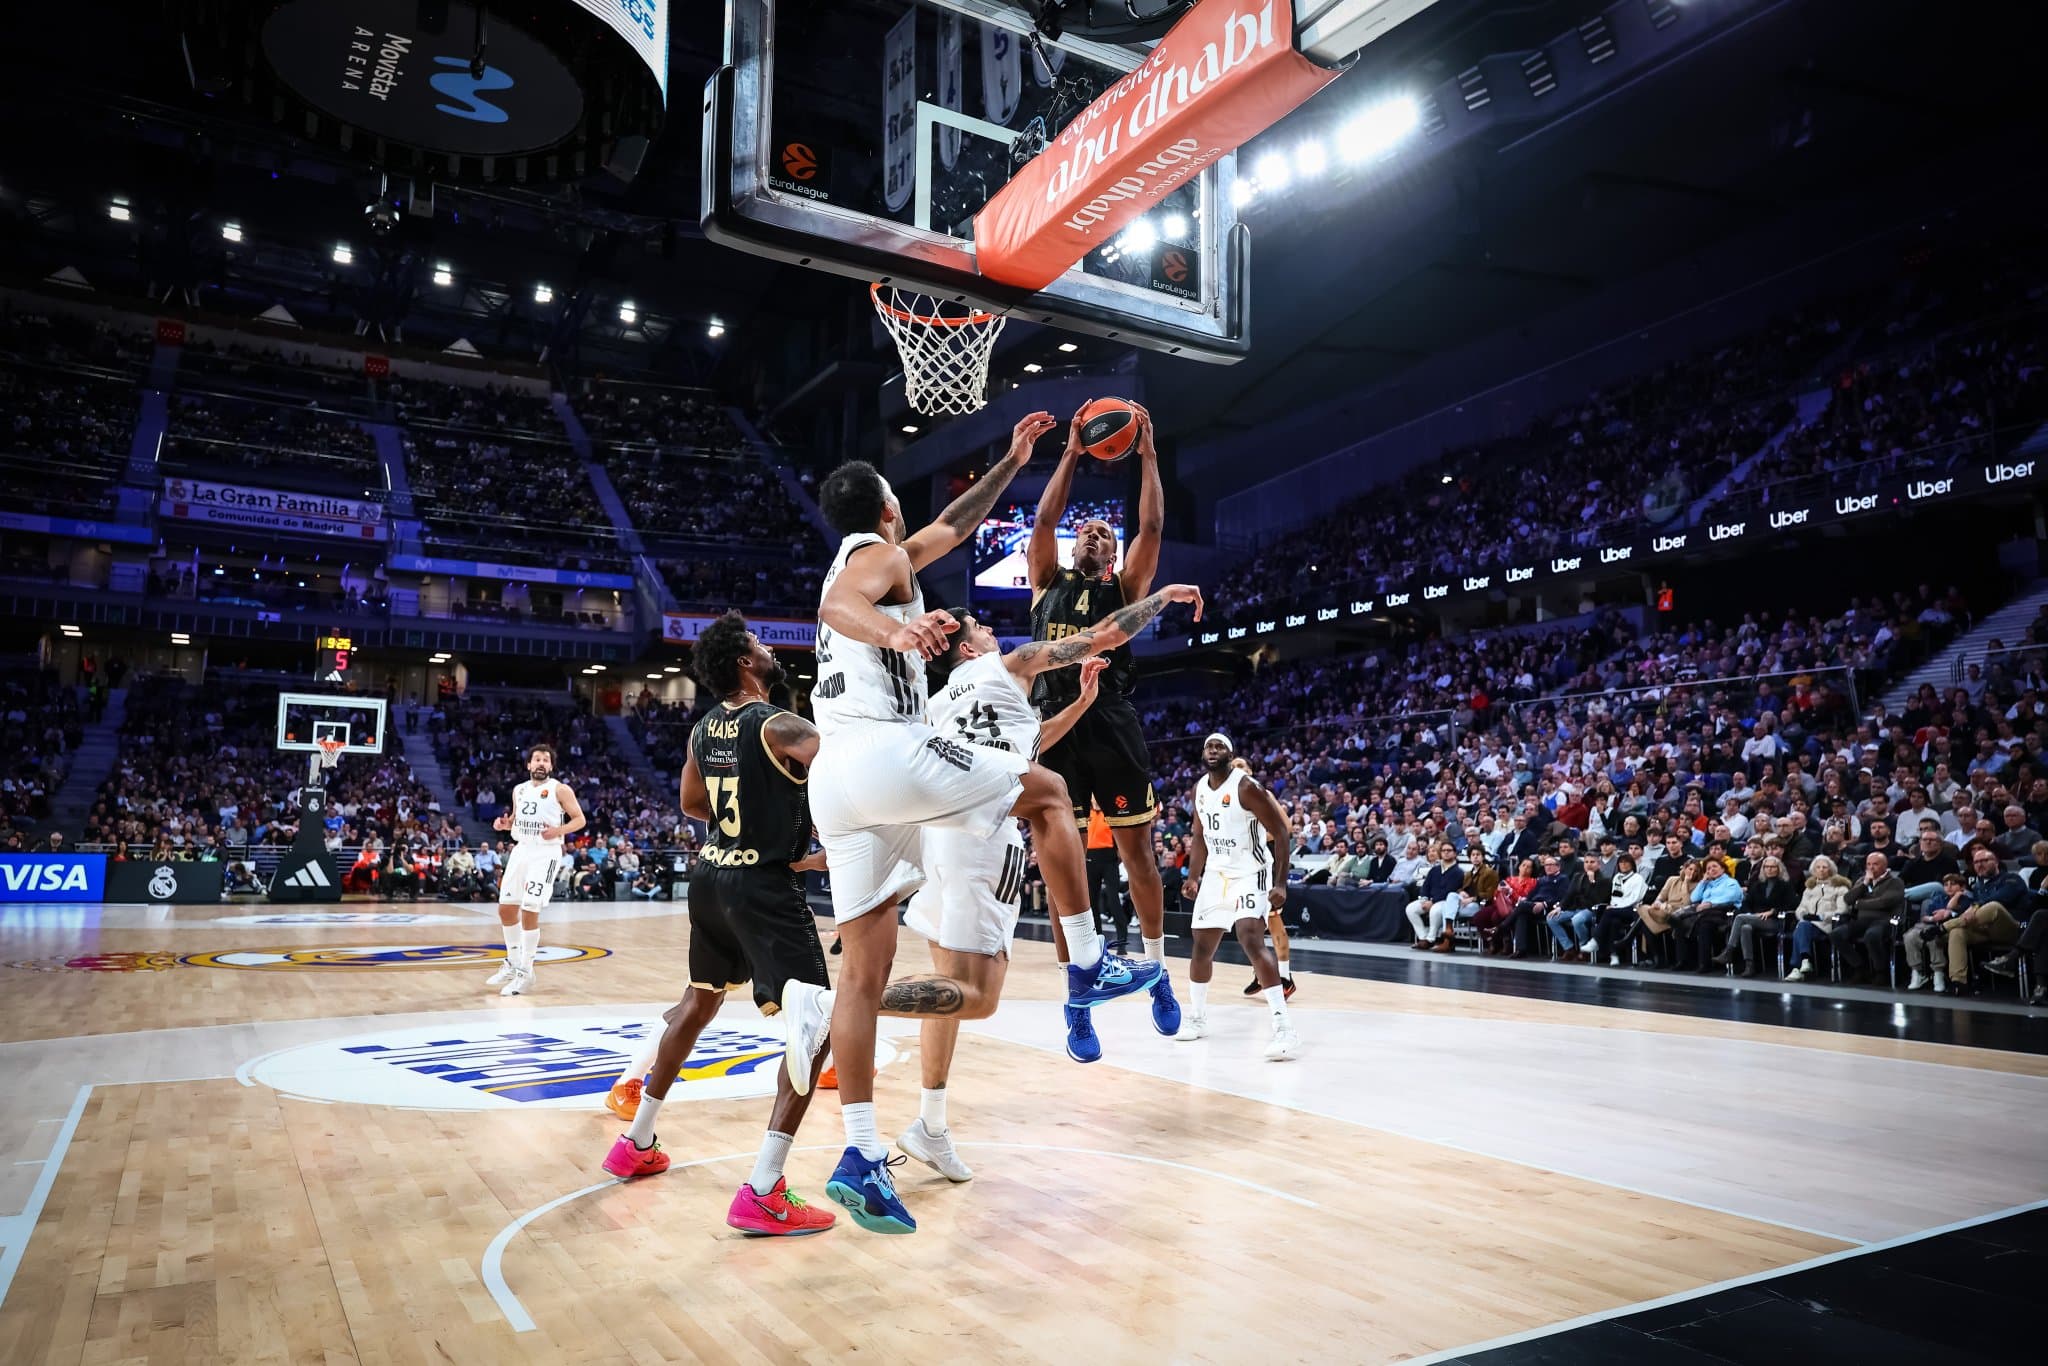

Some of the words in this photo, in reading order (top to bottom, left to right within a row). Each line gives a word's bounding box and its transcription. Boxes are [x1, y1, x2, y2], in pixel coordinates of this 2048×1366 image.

[342, 26, 374, 90] ARENA
[369, 33, 412, 101] Movistar
[1046, 114, 1123, 202] abu
[1128, 0, 1274, 137] dhabi
[1061, 47, 1167, 146] experience
[1136, 137, 1200, 176] abu
[1146, 147, 1221, 197] experience
[769, 176, 829, 199] EuroLeague
[1063, 176, 1145, 235] dhabi
[1153, 280, 1197, 297] EuroLeague
[192, 483, 216, 501] La
[221, 488, 271, 508] Gran
[276, 494, 350, 516] Familia
[208, 509, 279, 525] Comunidad
[284, 517, 298, 527] de
[303, 520, 344, 533] Madrid
[1202, 633, 1218, 643] Uber
[1229, 628, 1246, 638] Uber
[1257, 622, 1275, 633] Uber
[1286, 616, 1306, 627] Uber
[1318, 609, 1338, 620] Uber
[1351, 602, 1373, 614] Uber
[1387, 594, 1409, 607] Uber
[1424, 586, 1448, 599] Uber
[1464, 577, 1489, 590] Uber
[1506, 568, 1533, 582] Uber
[1552, 558, 1581, 572] Uber
[1601, 547, 1632, 562] Uber
[1653, 536, 1686, 552] Uber
[1709, 523, 1745, 540] Uber
[1770, 509, 1809, 528] Uber
[1836, 495, 1878, 514] Uber
[1908, 479, 1953, 499] Uber
[1986, 462, 2034, 483] Uber
[1074, 589, 1090, 615] 4
[327, 637, 351, 650] 9:25
[335, 651, 347, 670] 5
[522, 801, 538, 815] 23
[705, 776, 741, 837] 13
[1146, 782, 1155, 810] 4
[1206, 813, 1220, 830] 16
[699, 844, 760, 866] MONACO
[0, 863, 88, 891] VISA
[528, 881, 544, 896] 23
[1239, 894, 1256, 909] 16
